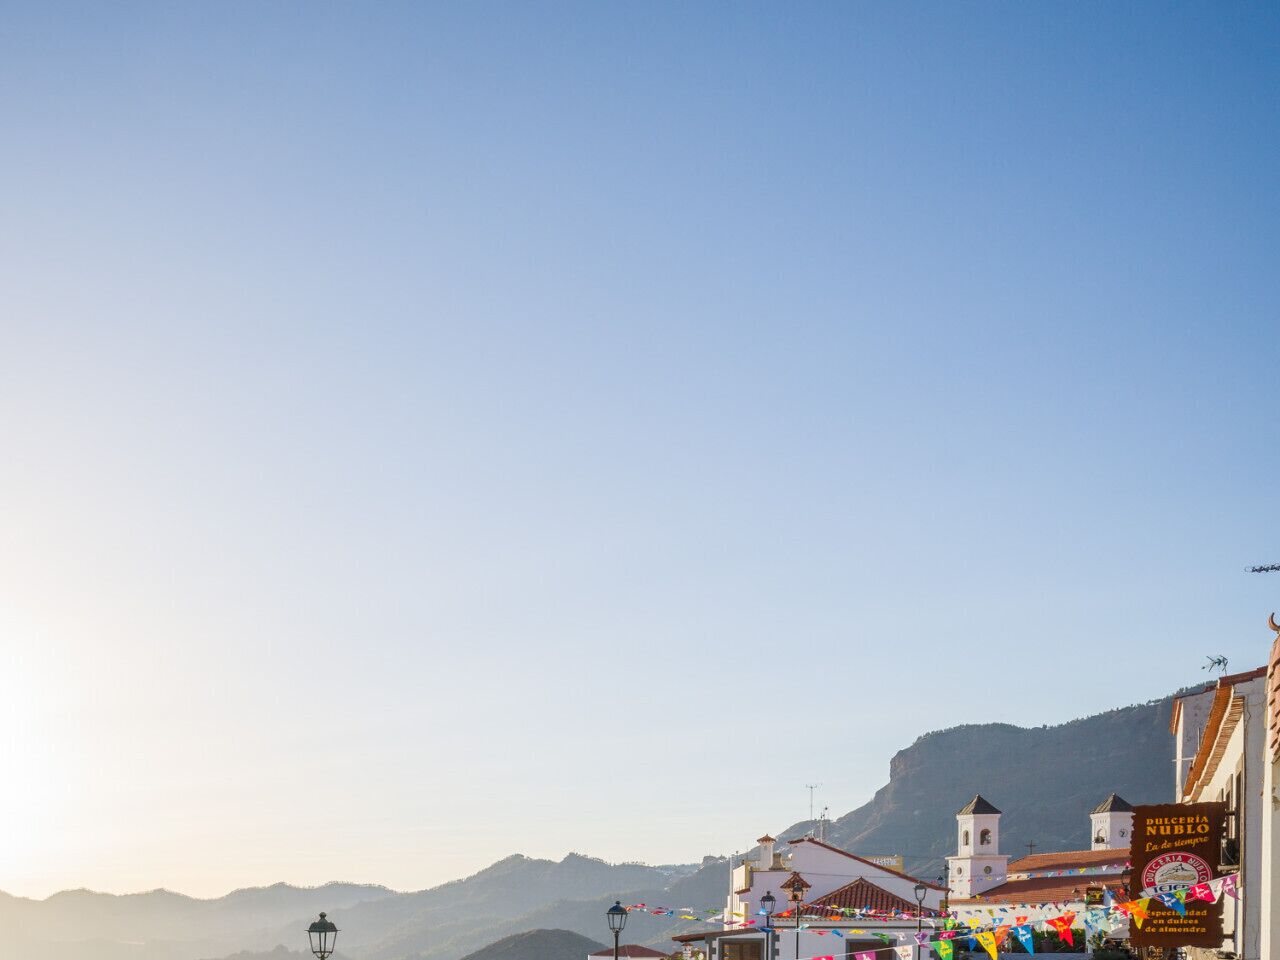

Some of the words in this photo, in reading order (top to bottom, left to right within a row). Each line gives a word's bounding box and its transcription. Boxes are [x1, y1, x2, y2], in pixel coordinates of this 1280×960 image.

[1146, 815, 1209, 825] DULCERÍA
[1146, 824, 1210, 836] NUBLO
[1145, 842, 1159, 852] La
[1174, 836, 1209, 848] siempre
[1188, 858, 1208, 883] NUBLO
